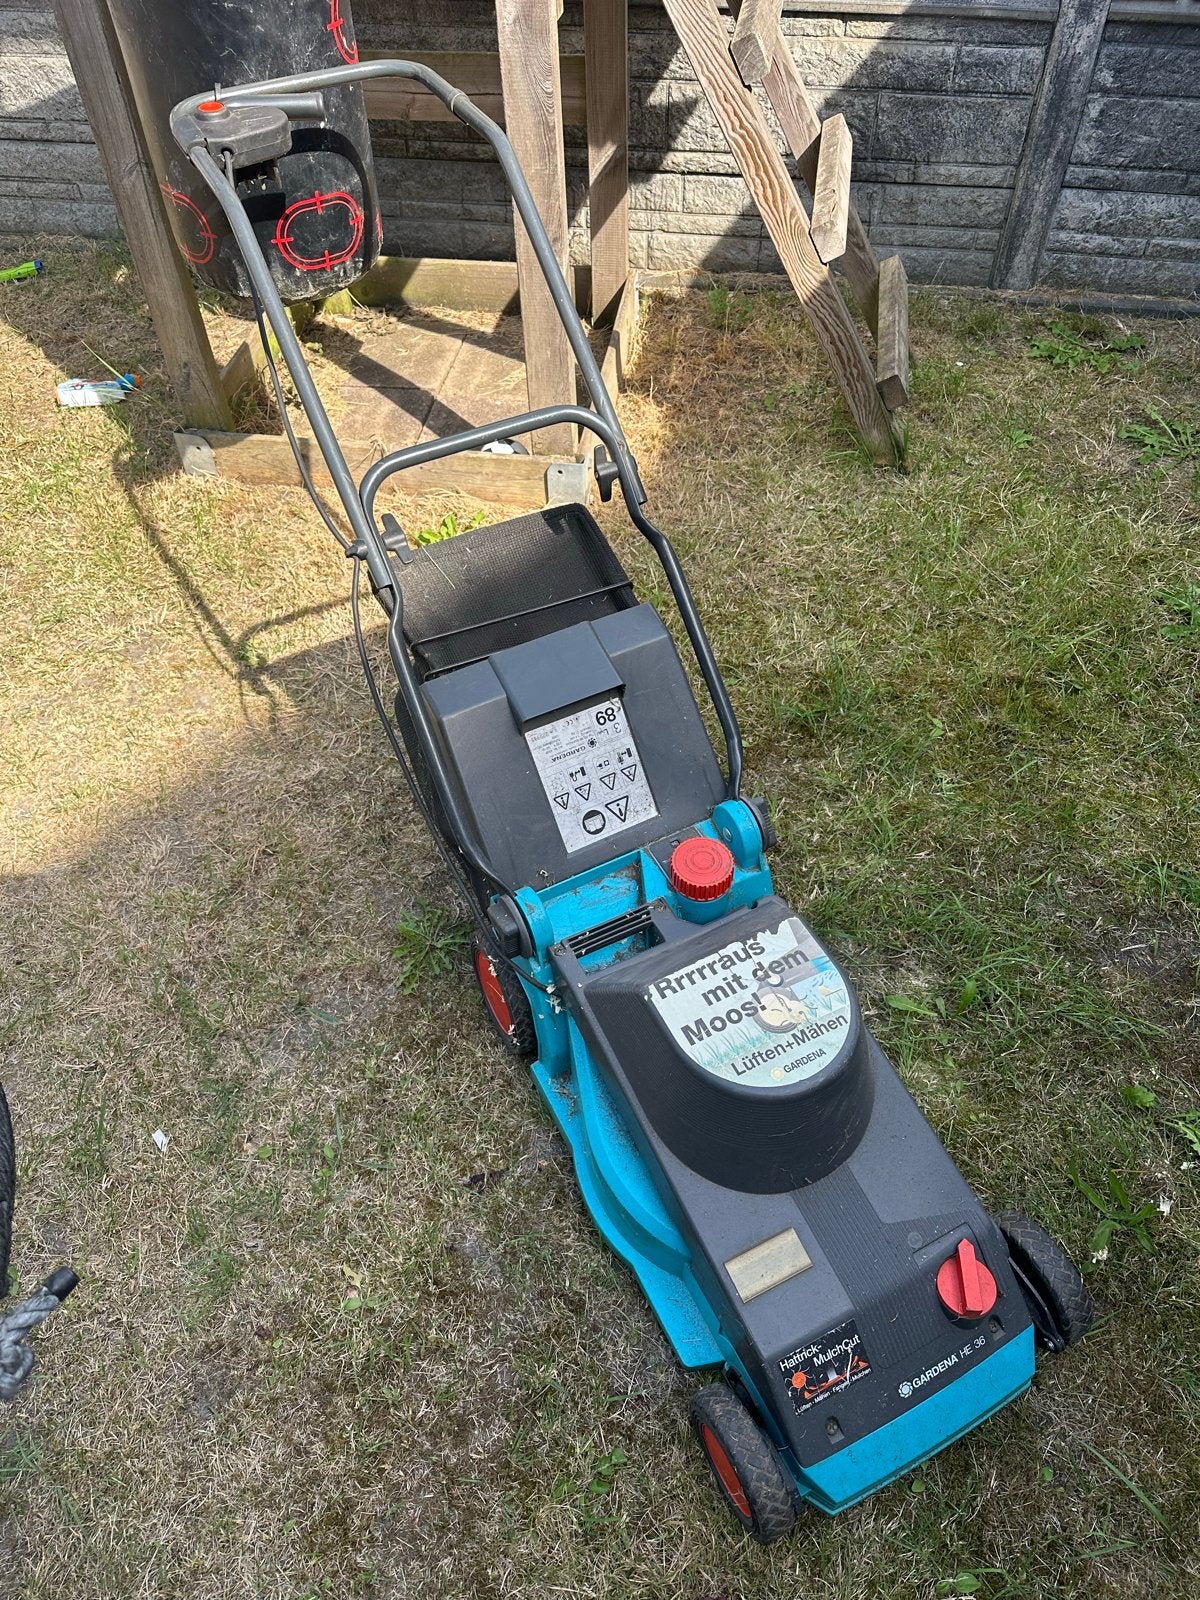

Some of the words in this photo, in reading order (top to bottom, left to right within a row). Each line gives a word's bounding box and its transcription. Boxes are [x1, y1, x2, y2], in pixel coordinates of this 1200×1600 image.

[595, 707, 616, 726] 89
[551, 745, 586, 763] GARDENA
[654, 941, 766, 1000] Rrrrraus
[701, 973, 749, 1007] mit
[751, 949, 810, 982] dem
[680, 992, 767, 1046] Moos!
[731, 1014, 849, 1076] Lüften+Mähen
[783, 1048, 827, 1073] GARDENA
[779, 1344, 822, 1372] Hattrick-
[813, 1334, 861, 1367] MulchCut
[912, 1354, 959, 1388] GARDENA
[959, 1344, 973, 1358] HE
[973, 1335, 986, 1349] 36
